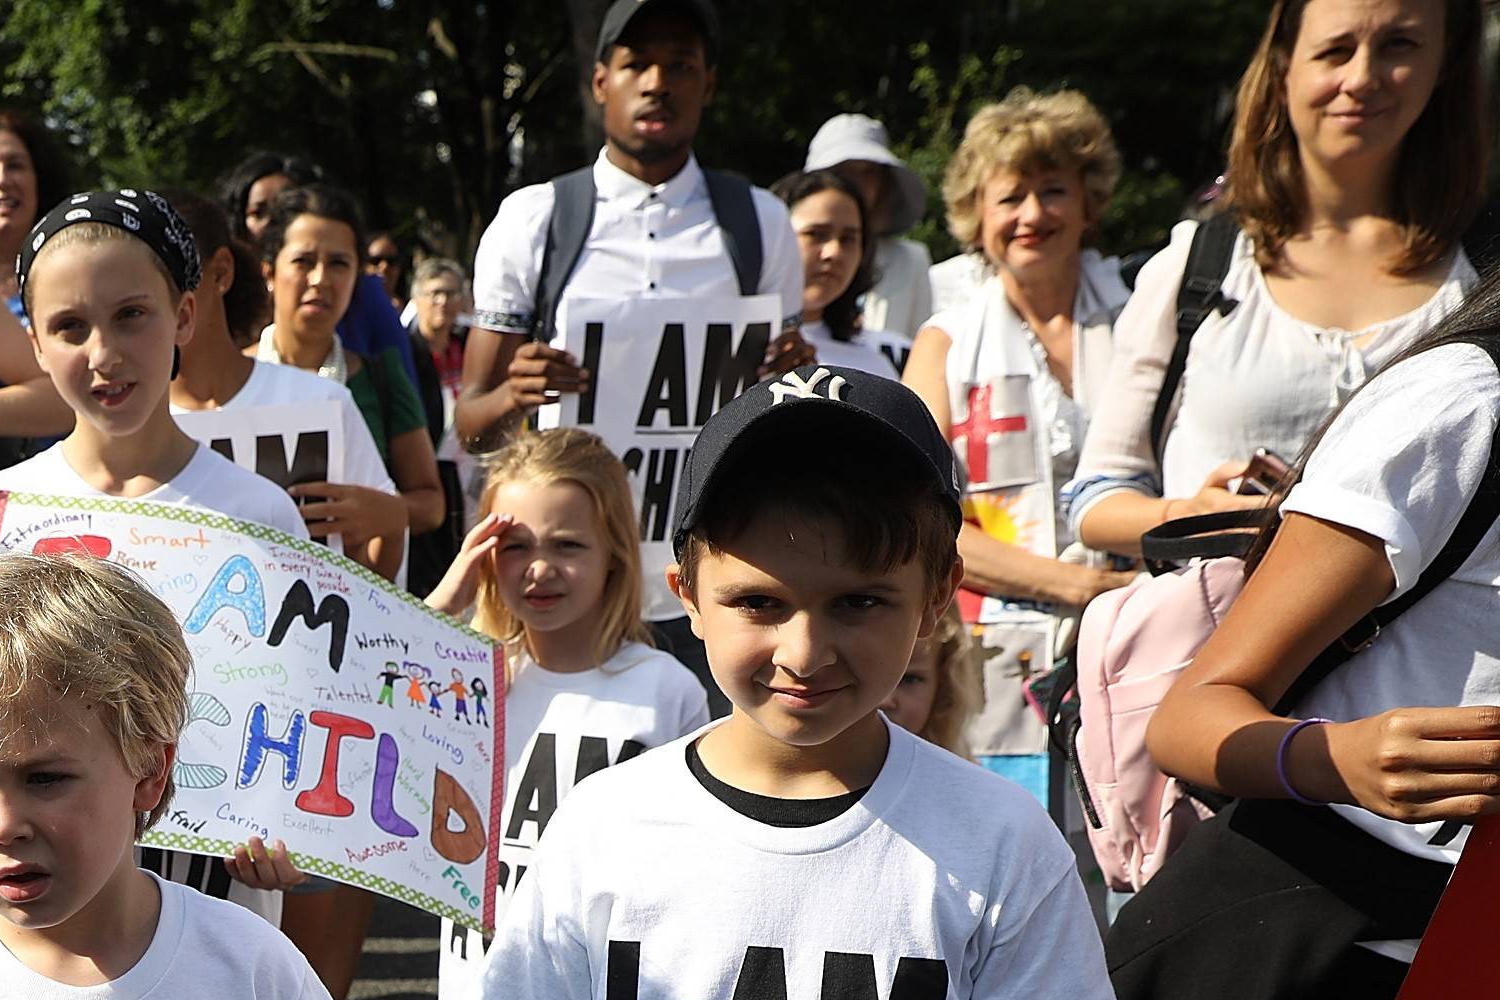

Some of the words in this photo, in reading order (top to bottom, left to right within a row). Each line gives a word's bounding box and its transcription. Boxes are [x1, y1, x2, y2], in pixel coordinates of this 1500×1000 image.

[578, 322, 604, 425] I
[211, 430, 329, 545] M
[0, 512, 93, 551] Extraordinary
[128, 526, 212, 548] Smart
[115, 551, 158, 571] Brave
[183, 552, 350, 674] AM
[212, 617, 253, 655] Happy
[355, 632, 410, 655] Worthy
[433, 641, 490, 666] Creative
[213, 660, 289, 687] Strong
[421, 724, 465, 766] Loving
[173, 691, 488, 866] CHILD
[216, 802, 269, 840] Caring
[345, 838, 408, 864] Awesome
[441, 865, 481, 910] Free
